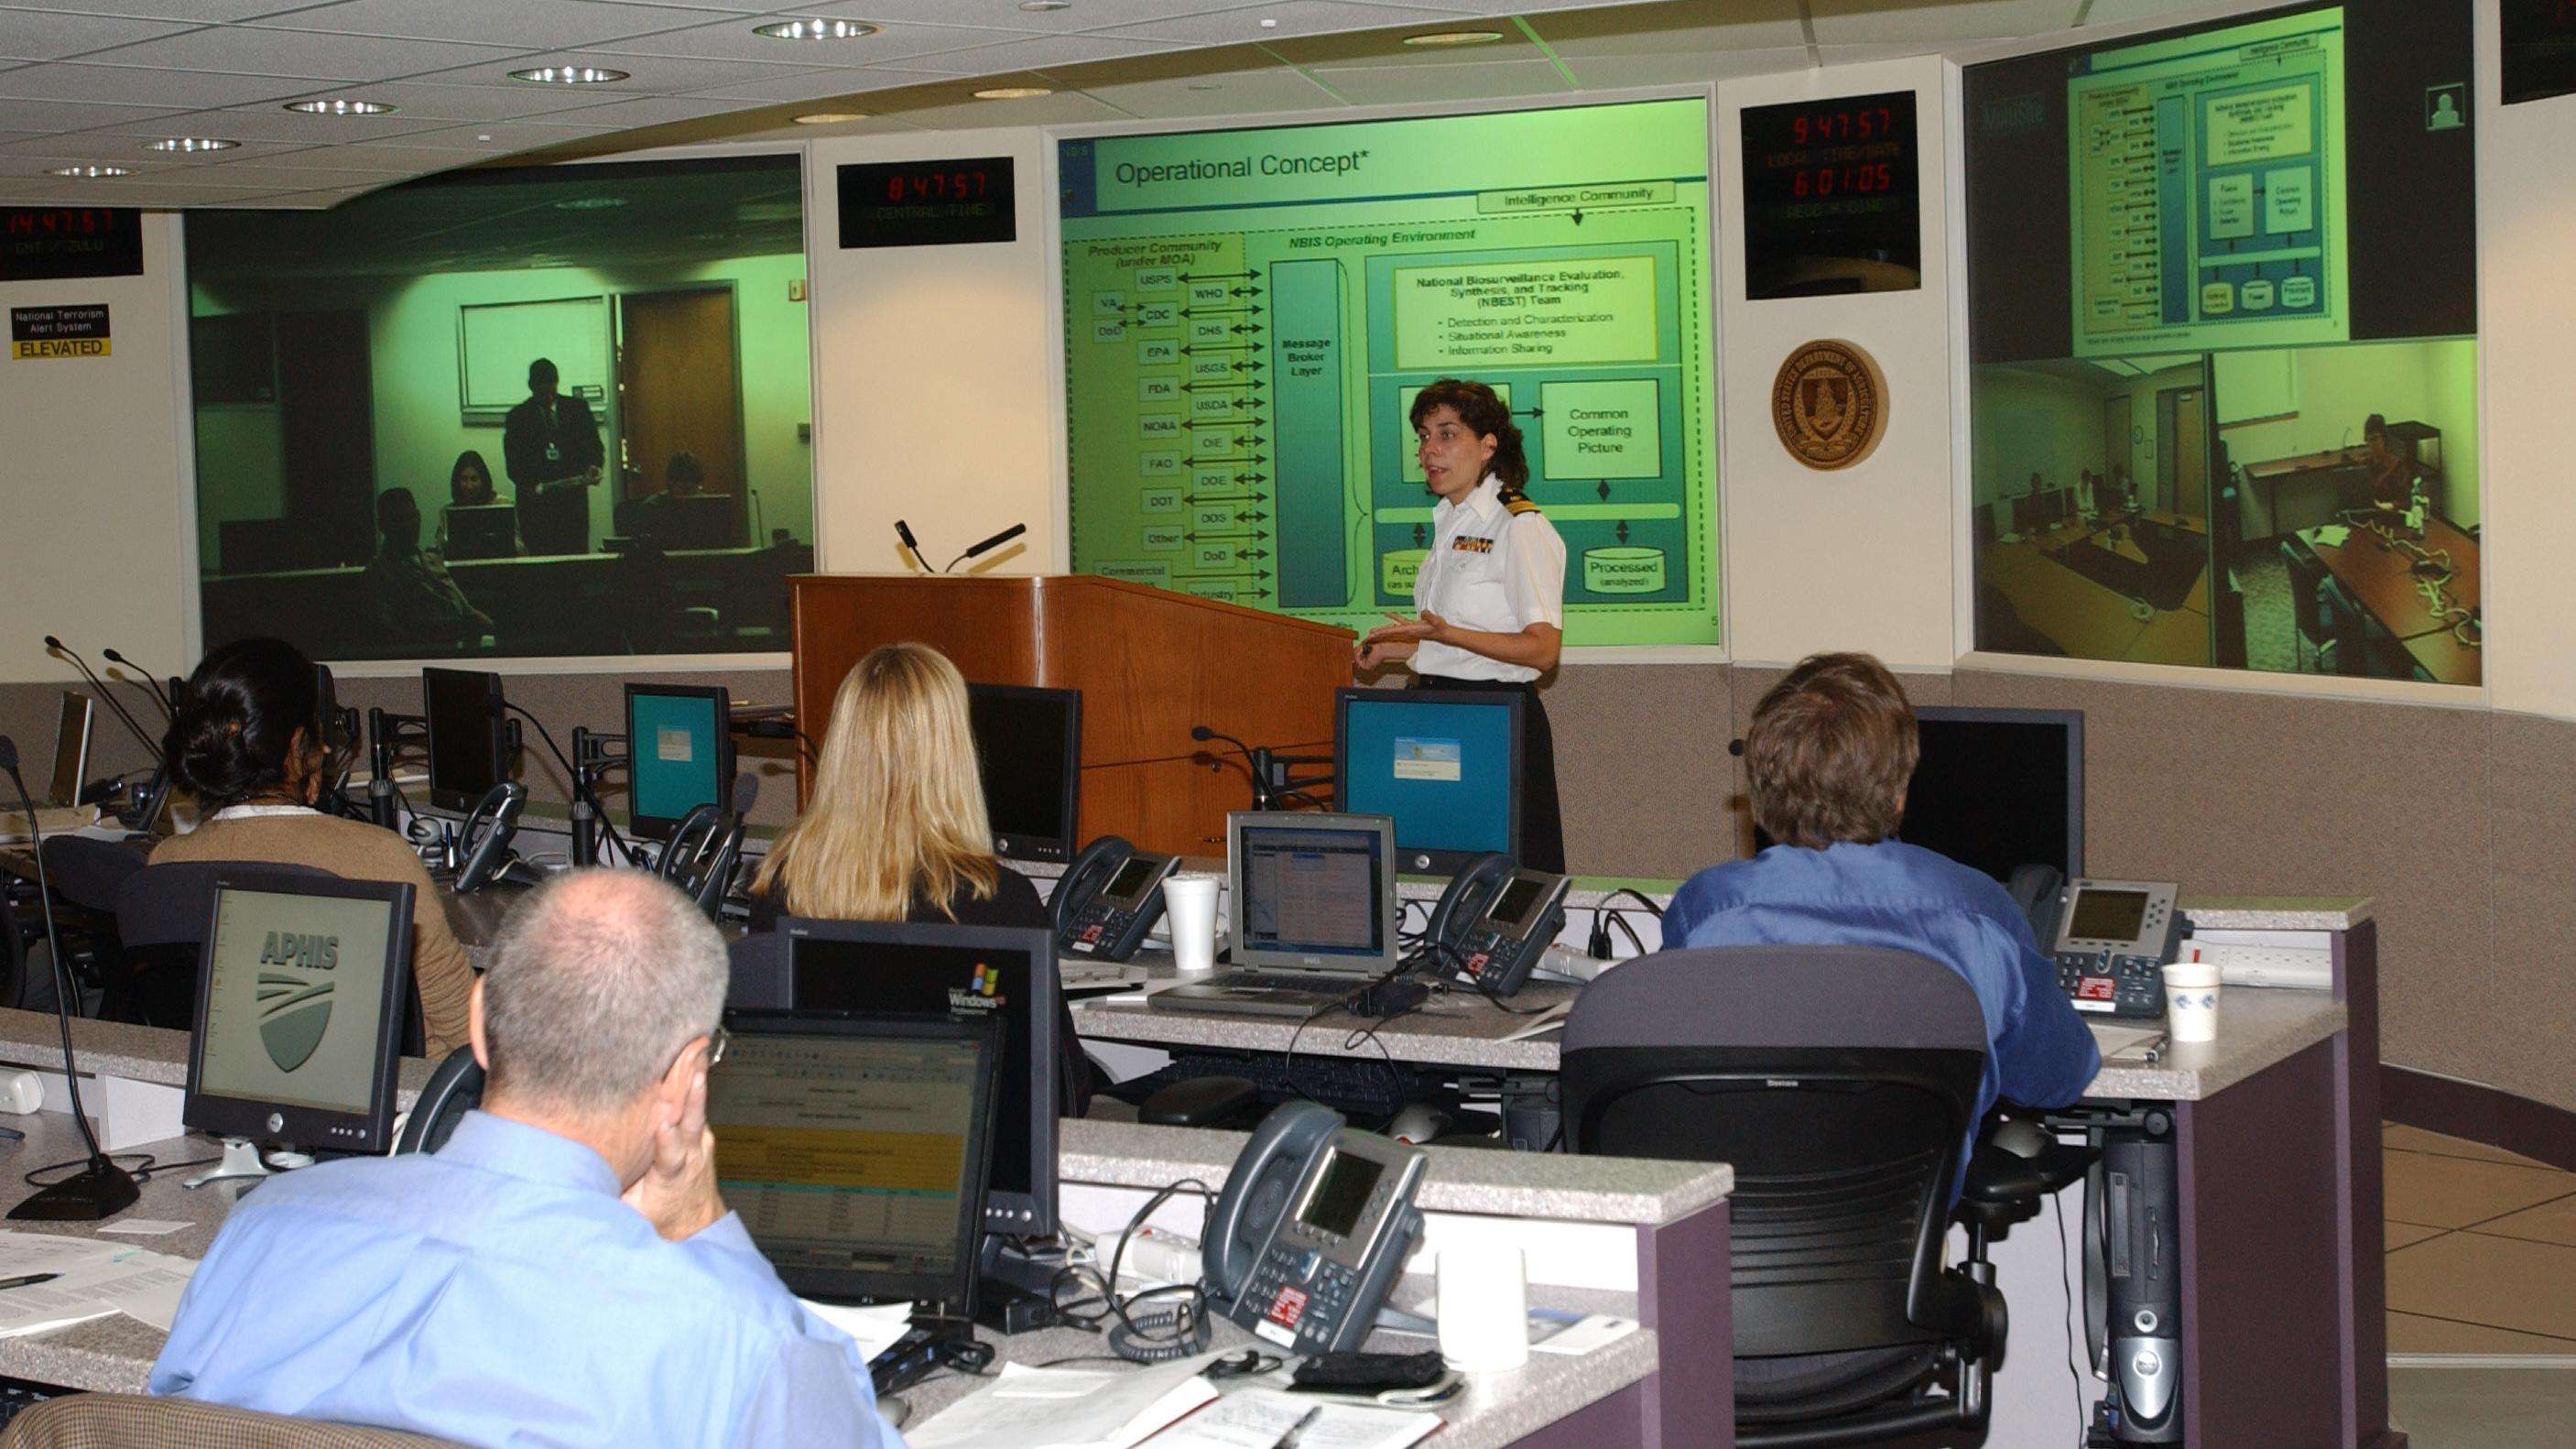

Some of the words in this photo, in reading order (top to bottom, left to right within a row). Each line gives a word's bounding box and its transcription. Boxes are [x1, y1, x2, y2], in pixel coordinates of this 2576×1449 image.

[1115, 157, 1251, 186] Operational
[1505, 191, 1576, 207] Intelligence
[1580, 186, 1654, 202] Community
[1289, 237, 1321, 249] NBIS
[1325, 233, 1387, 248] Operating
[1392, 228, 1475, 244] Environment
[1089, 244, 1146, 257] Producer
[1149, 240, 1223, 256] Community
[1417, 276, 1464, 289] National
[1466, 272, 1555, 286] Biosurveillance
[1194, 289, 1223, 300] WHO
[1513, 284, 1536, 294] and
[1538, 281, 1589, 296] Tracking
[1530, 294, 1561, 306] Team
[16, 311, 54, 322] National
[57, 310, 104, 320] Terrorism
[1146, 309, 1170, 320] CDC
[1448, 316, 1498, 329] Detection
[1500, 315, 1523, 326] and
[1524, 310, 1614, 325] Characterization
[30, 322, 52, 333] Alert
[57, 321, 92, 333] System
[1198, 325, 1223, 335] DHS
[1448, 330, 1504, 342] Situational
[1506, 327, 1567, 339] Awareness
[20, 340, 103, 356] ELEVATED
[1282, 338, 1331, 352] Message
[1448, 344, 1508, 355] Information
[1512, 342, 1554, 355] Sharing
[1147, 347, 1170, 357] EPA
[1288, 352, 1325, 363] Broker
[1291, 365, 1322, 378] Layer
[1570, 409, 1628, 420] Common
[1568, 425, 1632, 440] Operating
[1578, 441, 1624, 454] Picture
[1147, 533, 1179, 544] Other
[1102, 566, 1166, 578] Commercial
[1392, 564, 1419, 575] Arch
[1590, 561, 1658, 573] Processed
[261, 931, 339, 970] APHIS
[949, 993, 996, 1009] Windows
